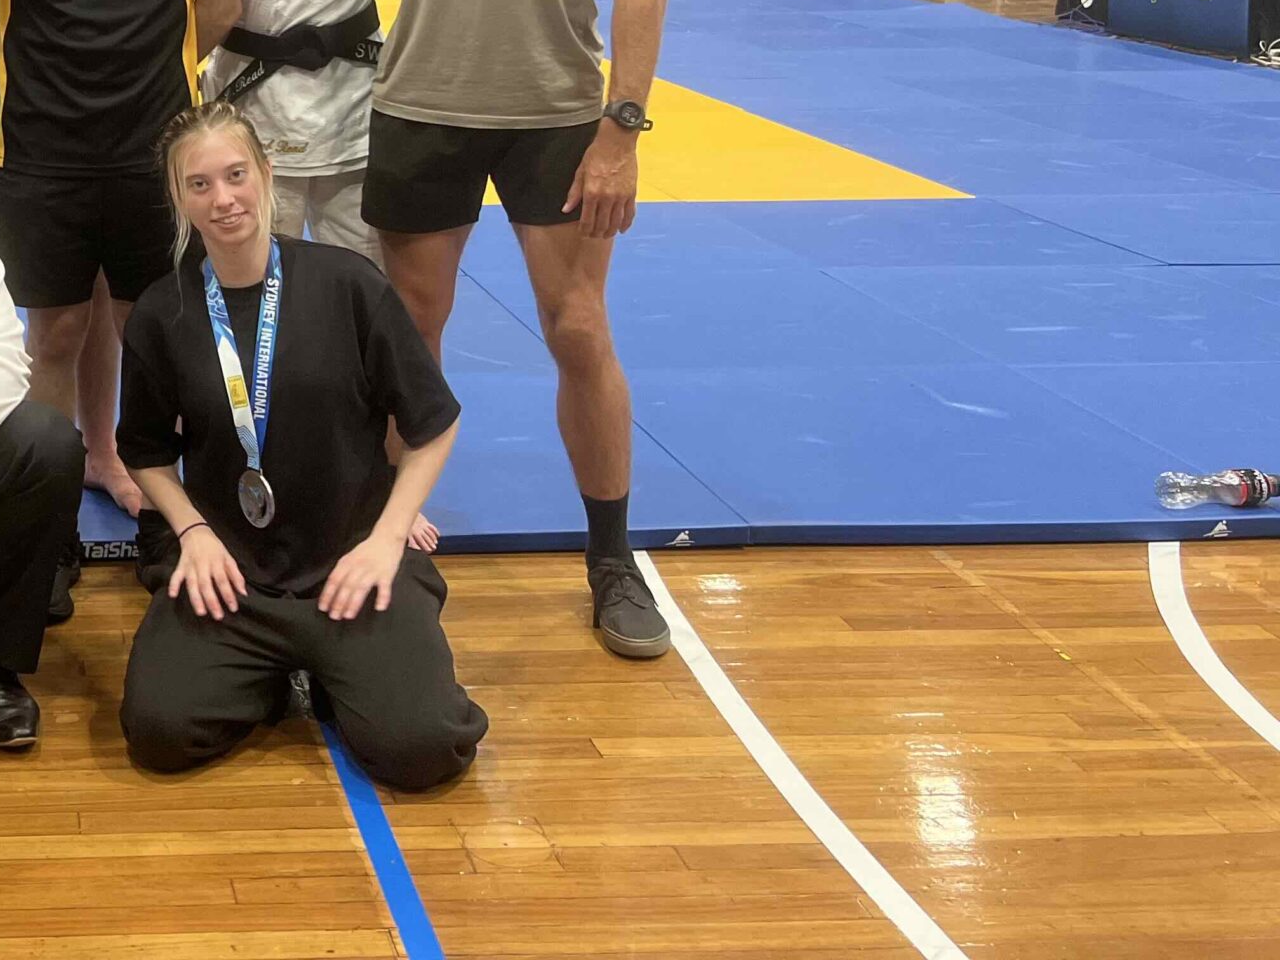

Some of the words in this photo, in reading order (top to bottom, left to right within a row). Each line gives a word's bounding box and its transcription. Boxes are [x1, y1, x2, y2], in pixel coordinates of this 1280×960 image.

[264, 277, 280, 325] SYDNEY
[254, 329, 273, 420] INTERNATIONAL
[82, 542, 139, 558] TaiSha
